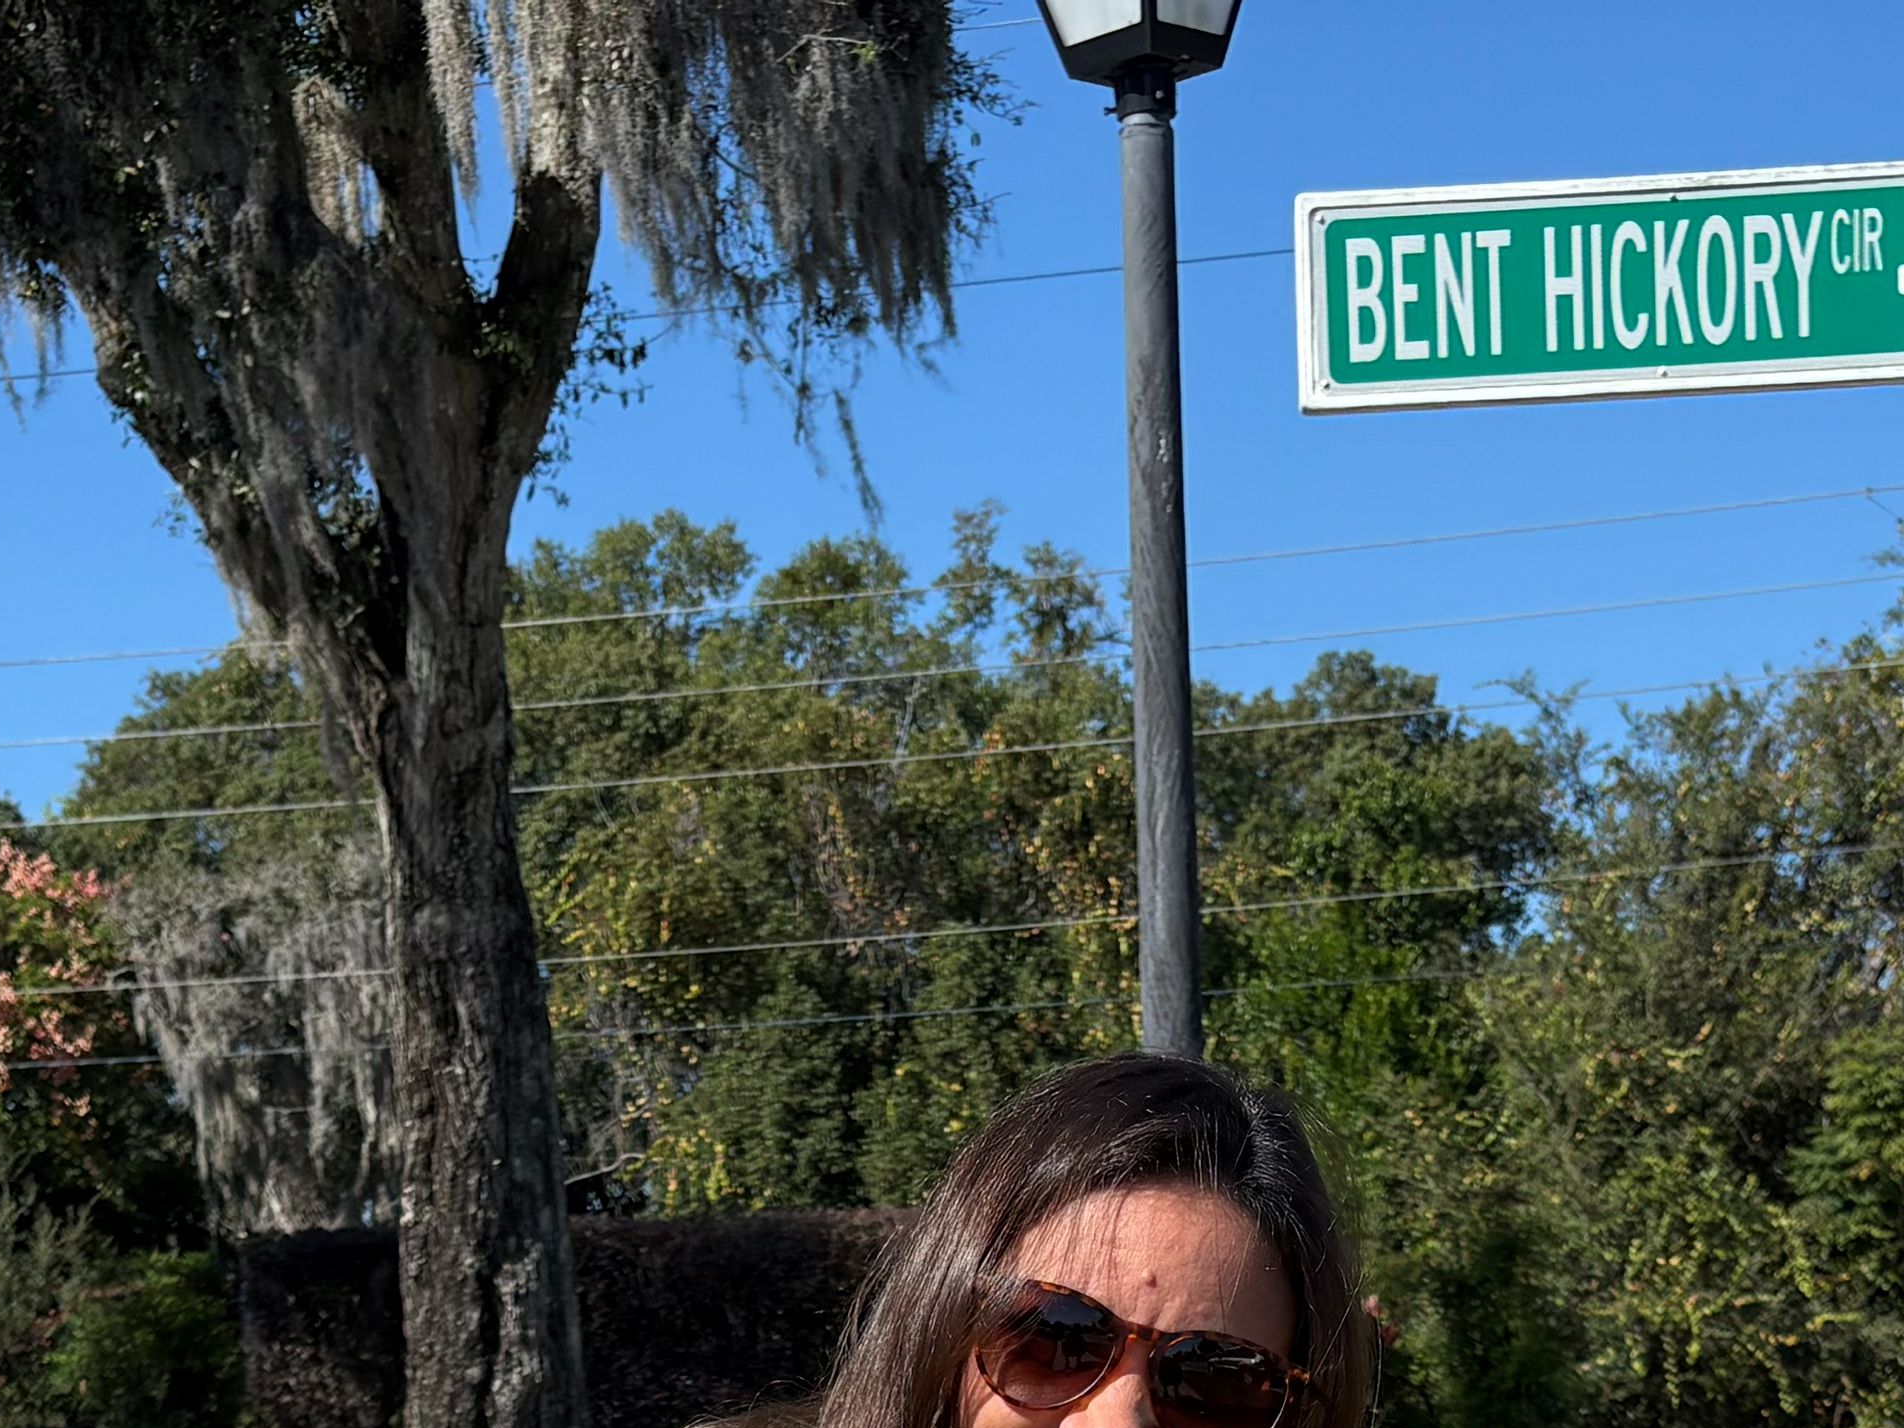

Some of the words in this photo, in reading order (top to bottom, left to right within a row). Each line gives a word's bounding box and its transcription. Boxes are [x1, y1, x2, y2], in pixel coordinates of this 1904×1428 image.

[1345, 228, 1512, 364] BENT
[1543, 210, 1824, 352] HICKORY
[1829, 207, 1884, 274] CIR
